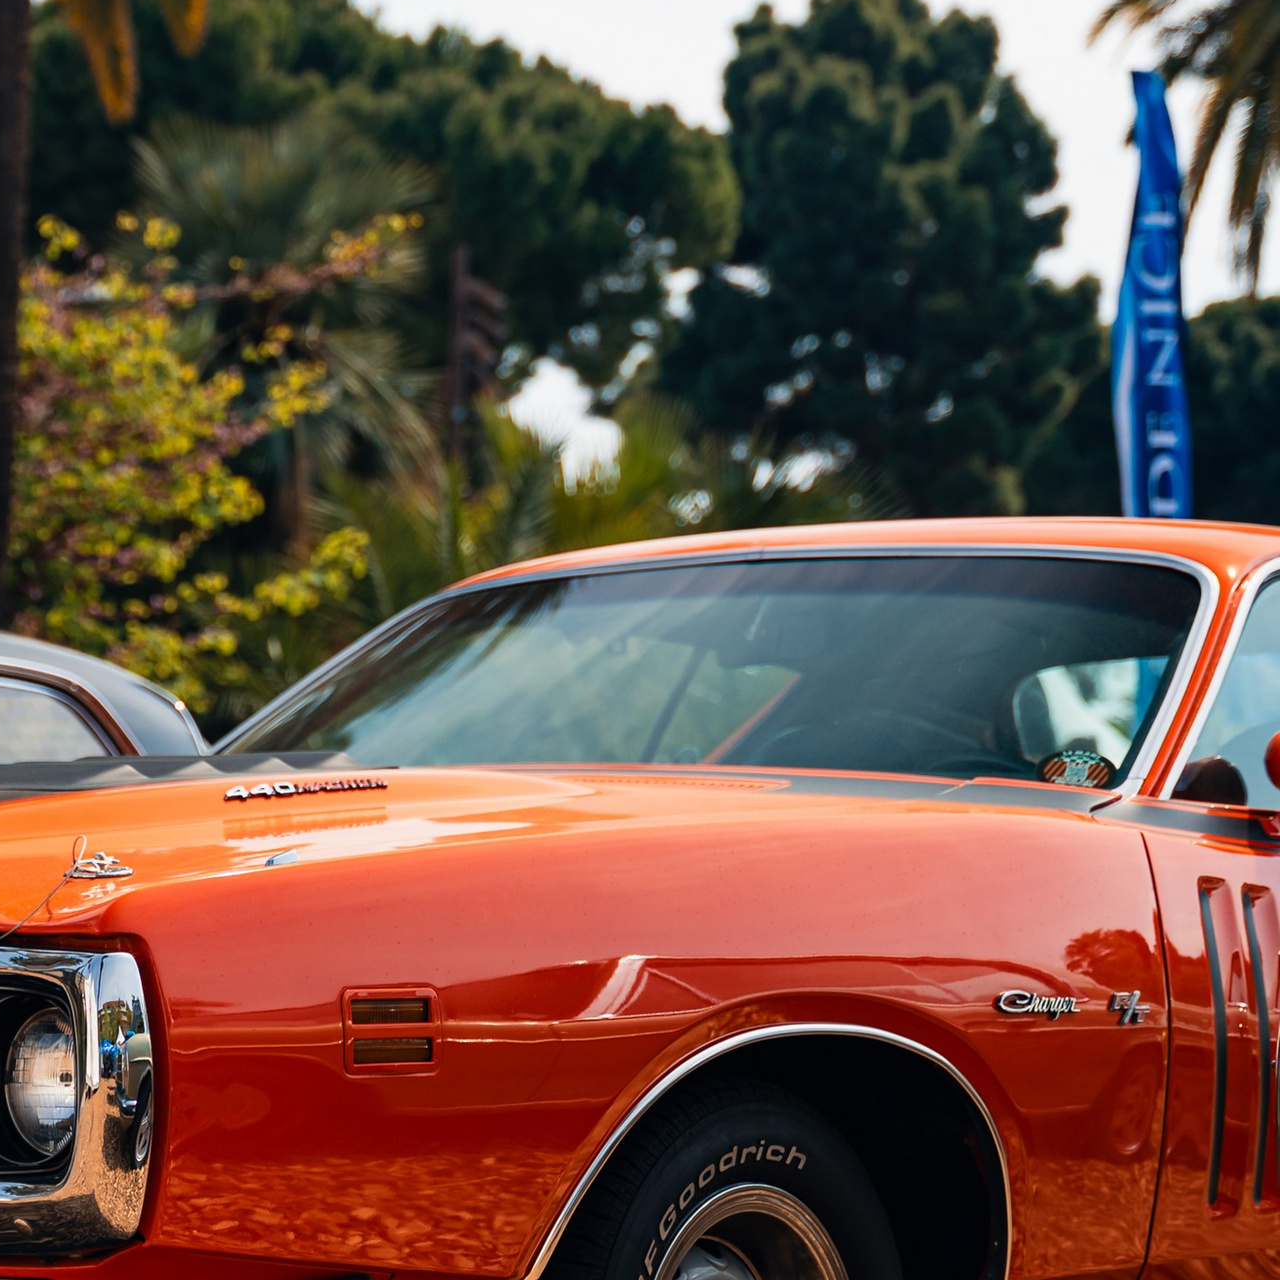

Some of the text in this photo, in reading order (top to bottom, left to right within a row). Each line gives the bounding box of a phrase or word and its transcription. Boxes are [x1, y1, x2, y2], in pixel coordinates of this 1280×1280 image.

[1132, 193, 1185, 518] DE NICE
[224, 781, 297, 801] 440
[998, 989, 1151, 1024] Charger R/T
